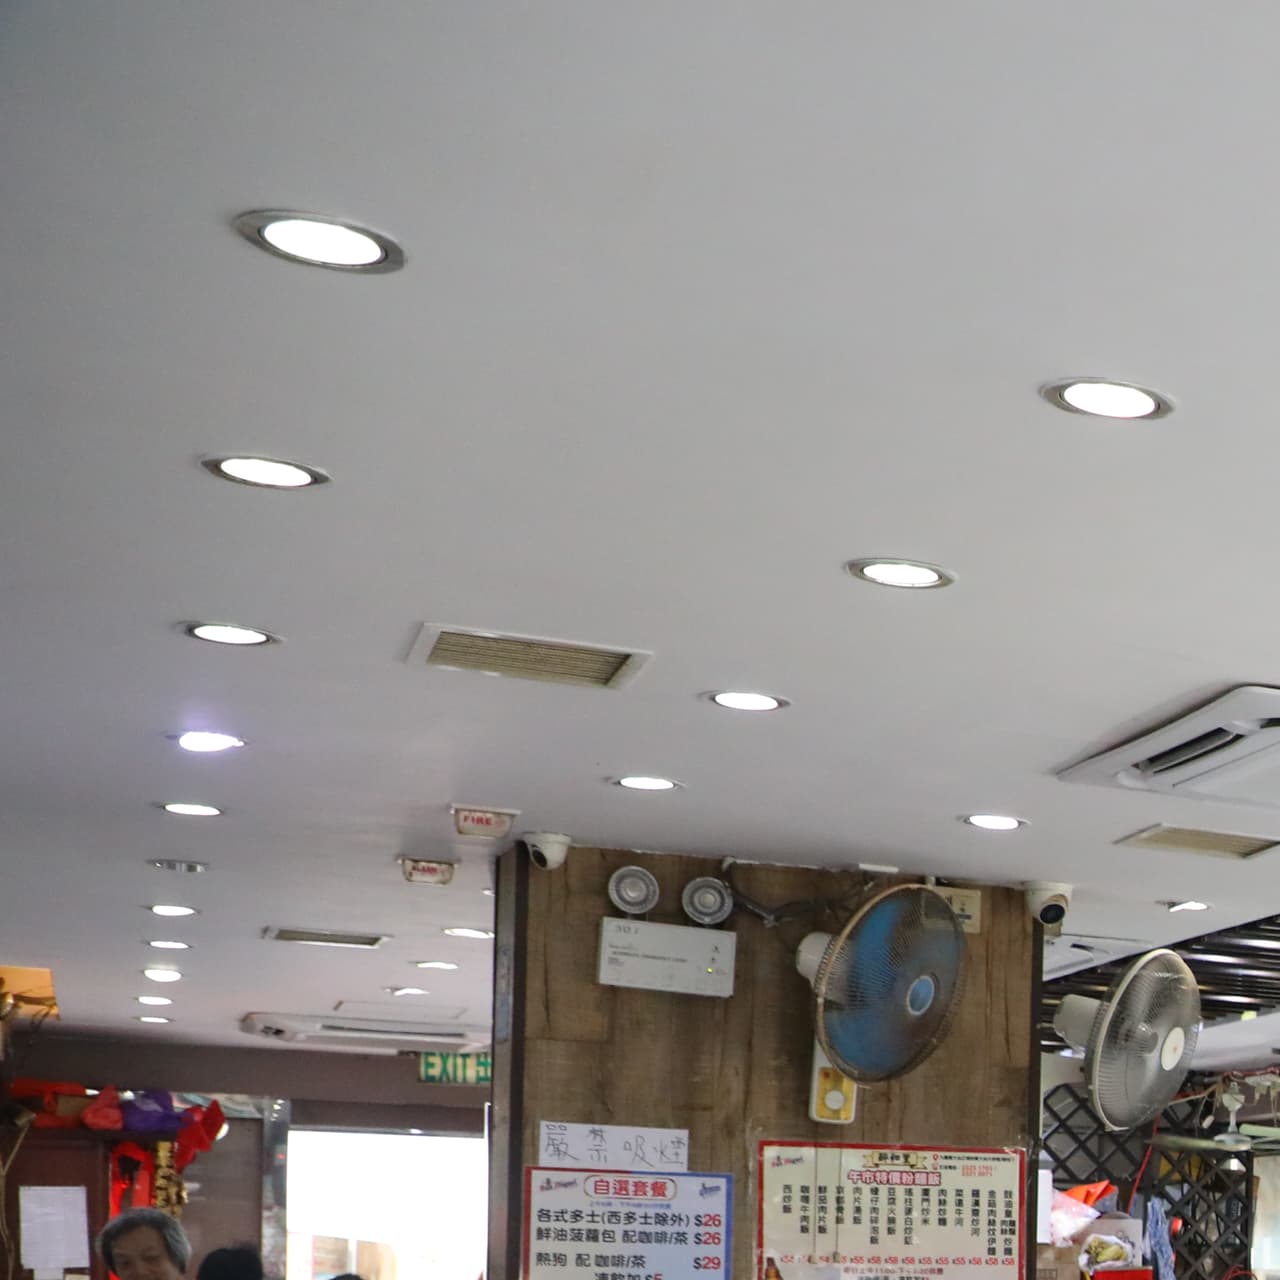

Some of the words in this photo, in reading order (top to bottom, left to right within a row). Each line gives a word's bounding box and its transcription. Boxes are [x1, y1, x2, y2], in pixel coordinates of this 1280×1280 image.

[464, 816, 492, 826] FIRE
[424, 1052, 470, 1082] EXIT
[594, 1179, 668, 1198] 自選套餐
[694, 1214, 721, 1227] $26
[694, 1232, 720, 1245] $26
[693, 1256, 720, 1270] $29
